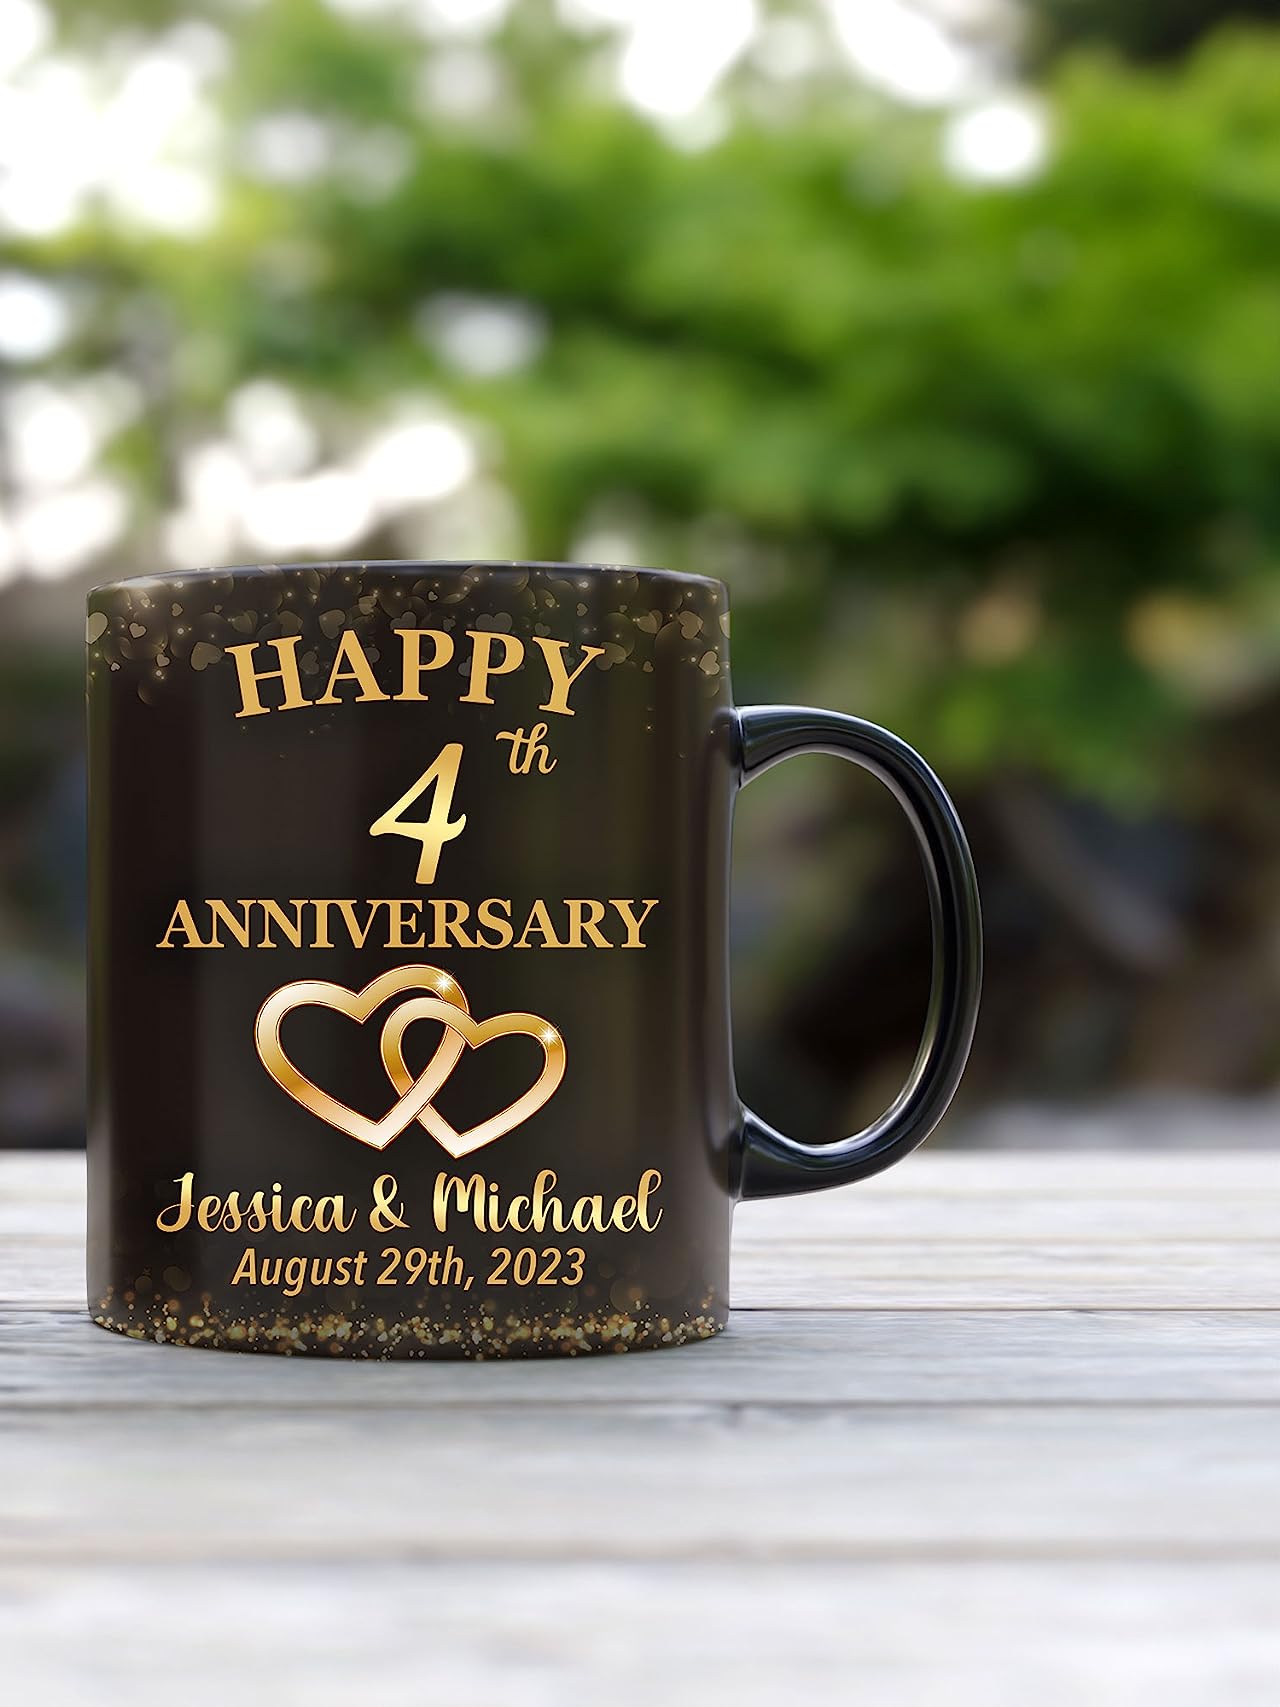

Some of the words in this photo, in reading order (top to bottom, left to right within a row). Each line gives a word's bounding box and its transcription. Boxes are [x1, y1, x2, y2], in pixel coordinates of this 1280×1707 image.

[225, 629, 605, 718] HAPPY
[369, 743, 467, 884] 4
[495, 722, 558, 774] th
[156, 899, 659, 949] ANNIVERSARY
[157, 1172, 358, 1233] Jessica
[370, 1175, 411, 1232] &
[433, 1170, 664, 1233] Michael
[231, 1249, 368, 1297] August
[376, 1246, 476, 1290] 29th,
[487, 1247, 586, 1286] 2023
